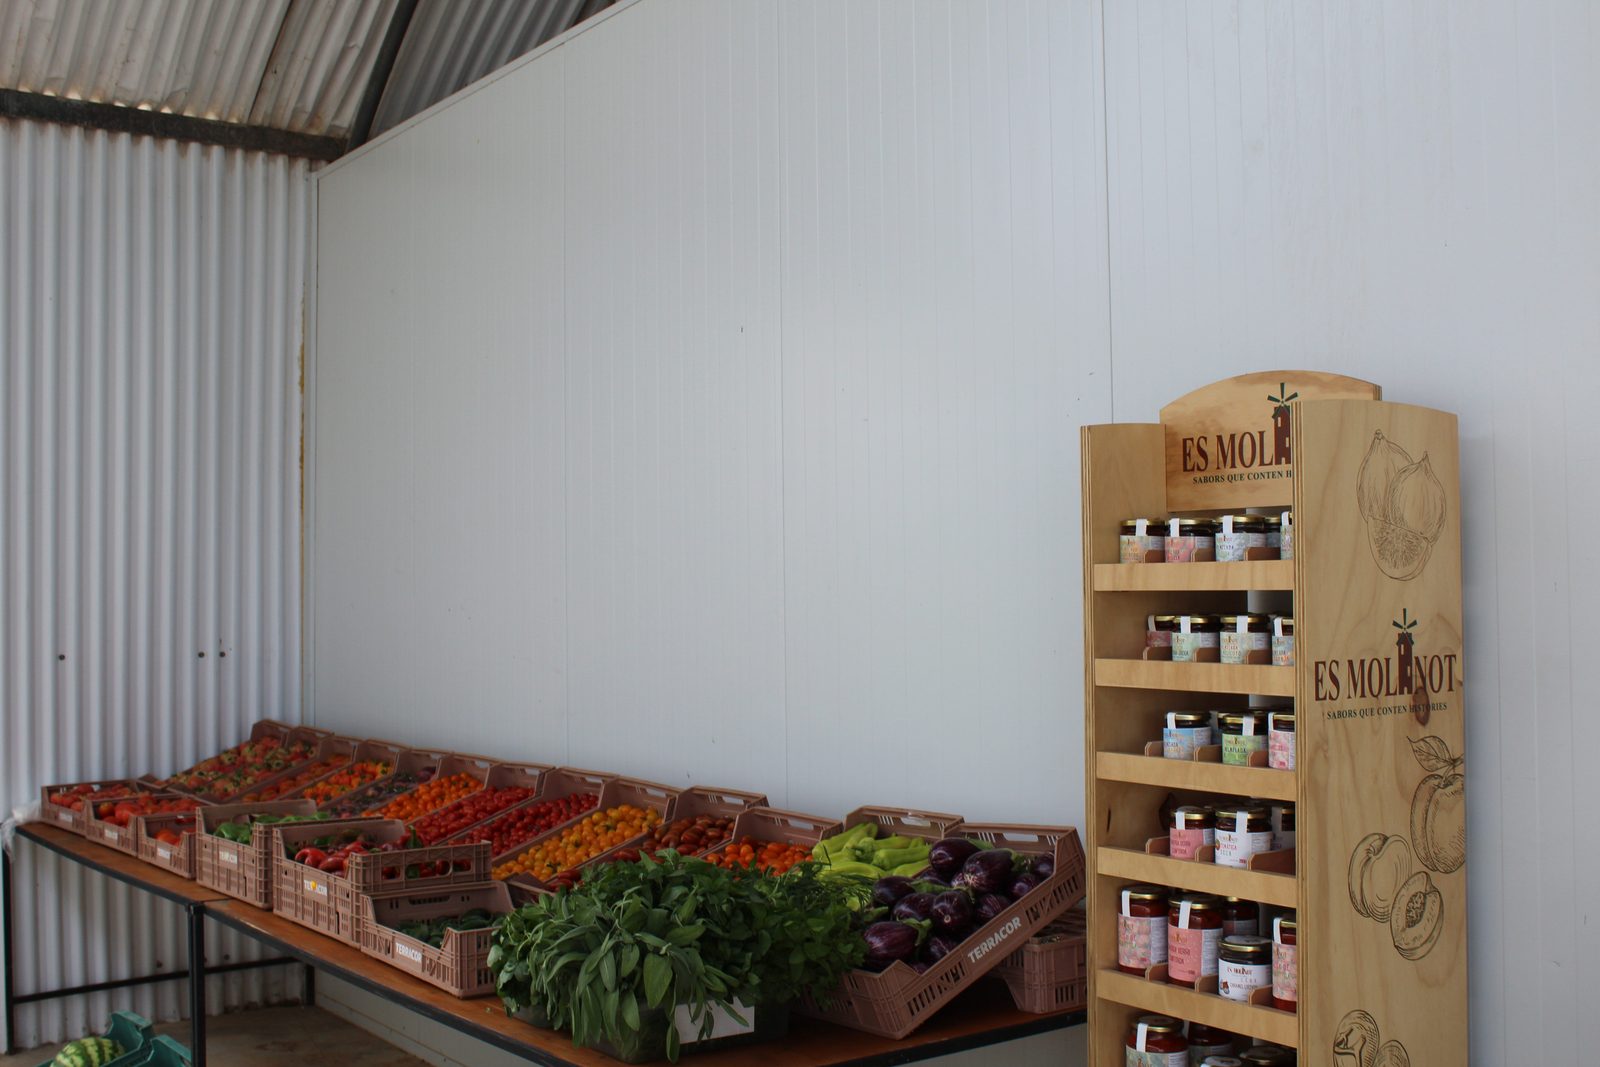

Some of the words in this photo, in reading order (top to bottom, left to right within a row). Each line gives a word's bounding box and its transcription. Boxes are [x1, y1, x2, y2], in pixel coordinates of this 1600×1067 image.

[1182, 436, 1209, 472] ES
[1193, 474, 1225, 485] SABORS
[1227, 473, 1245, 483] QUE
[1247, 471, 1282, 481] CONTEN
[1314, 659, 1341, 702] ES
[1327, 710, 1358, 720] SABORS
[1359, 709, 1376, 719] QUE
[1377, 705, 1408, 716] CONTEN
[1409, 703, 1448, 713] HISTORIES
[967, 916, 1022, 963] TERRACOR
